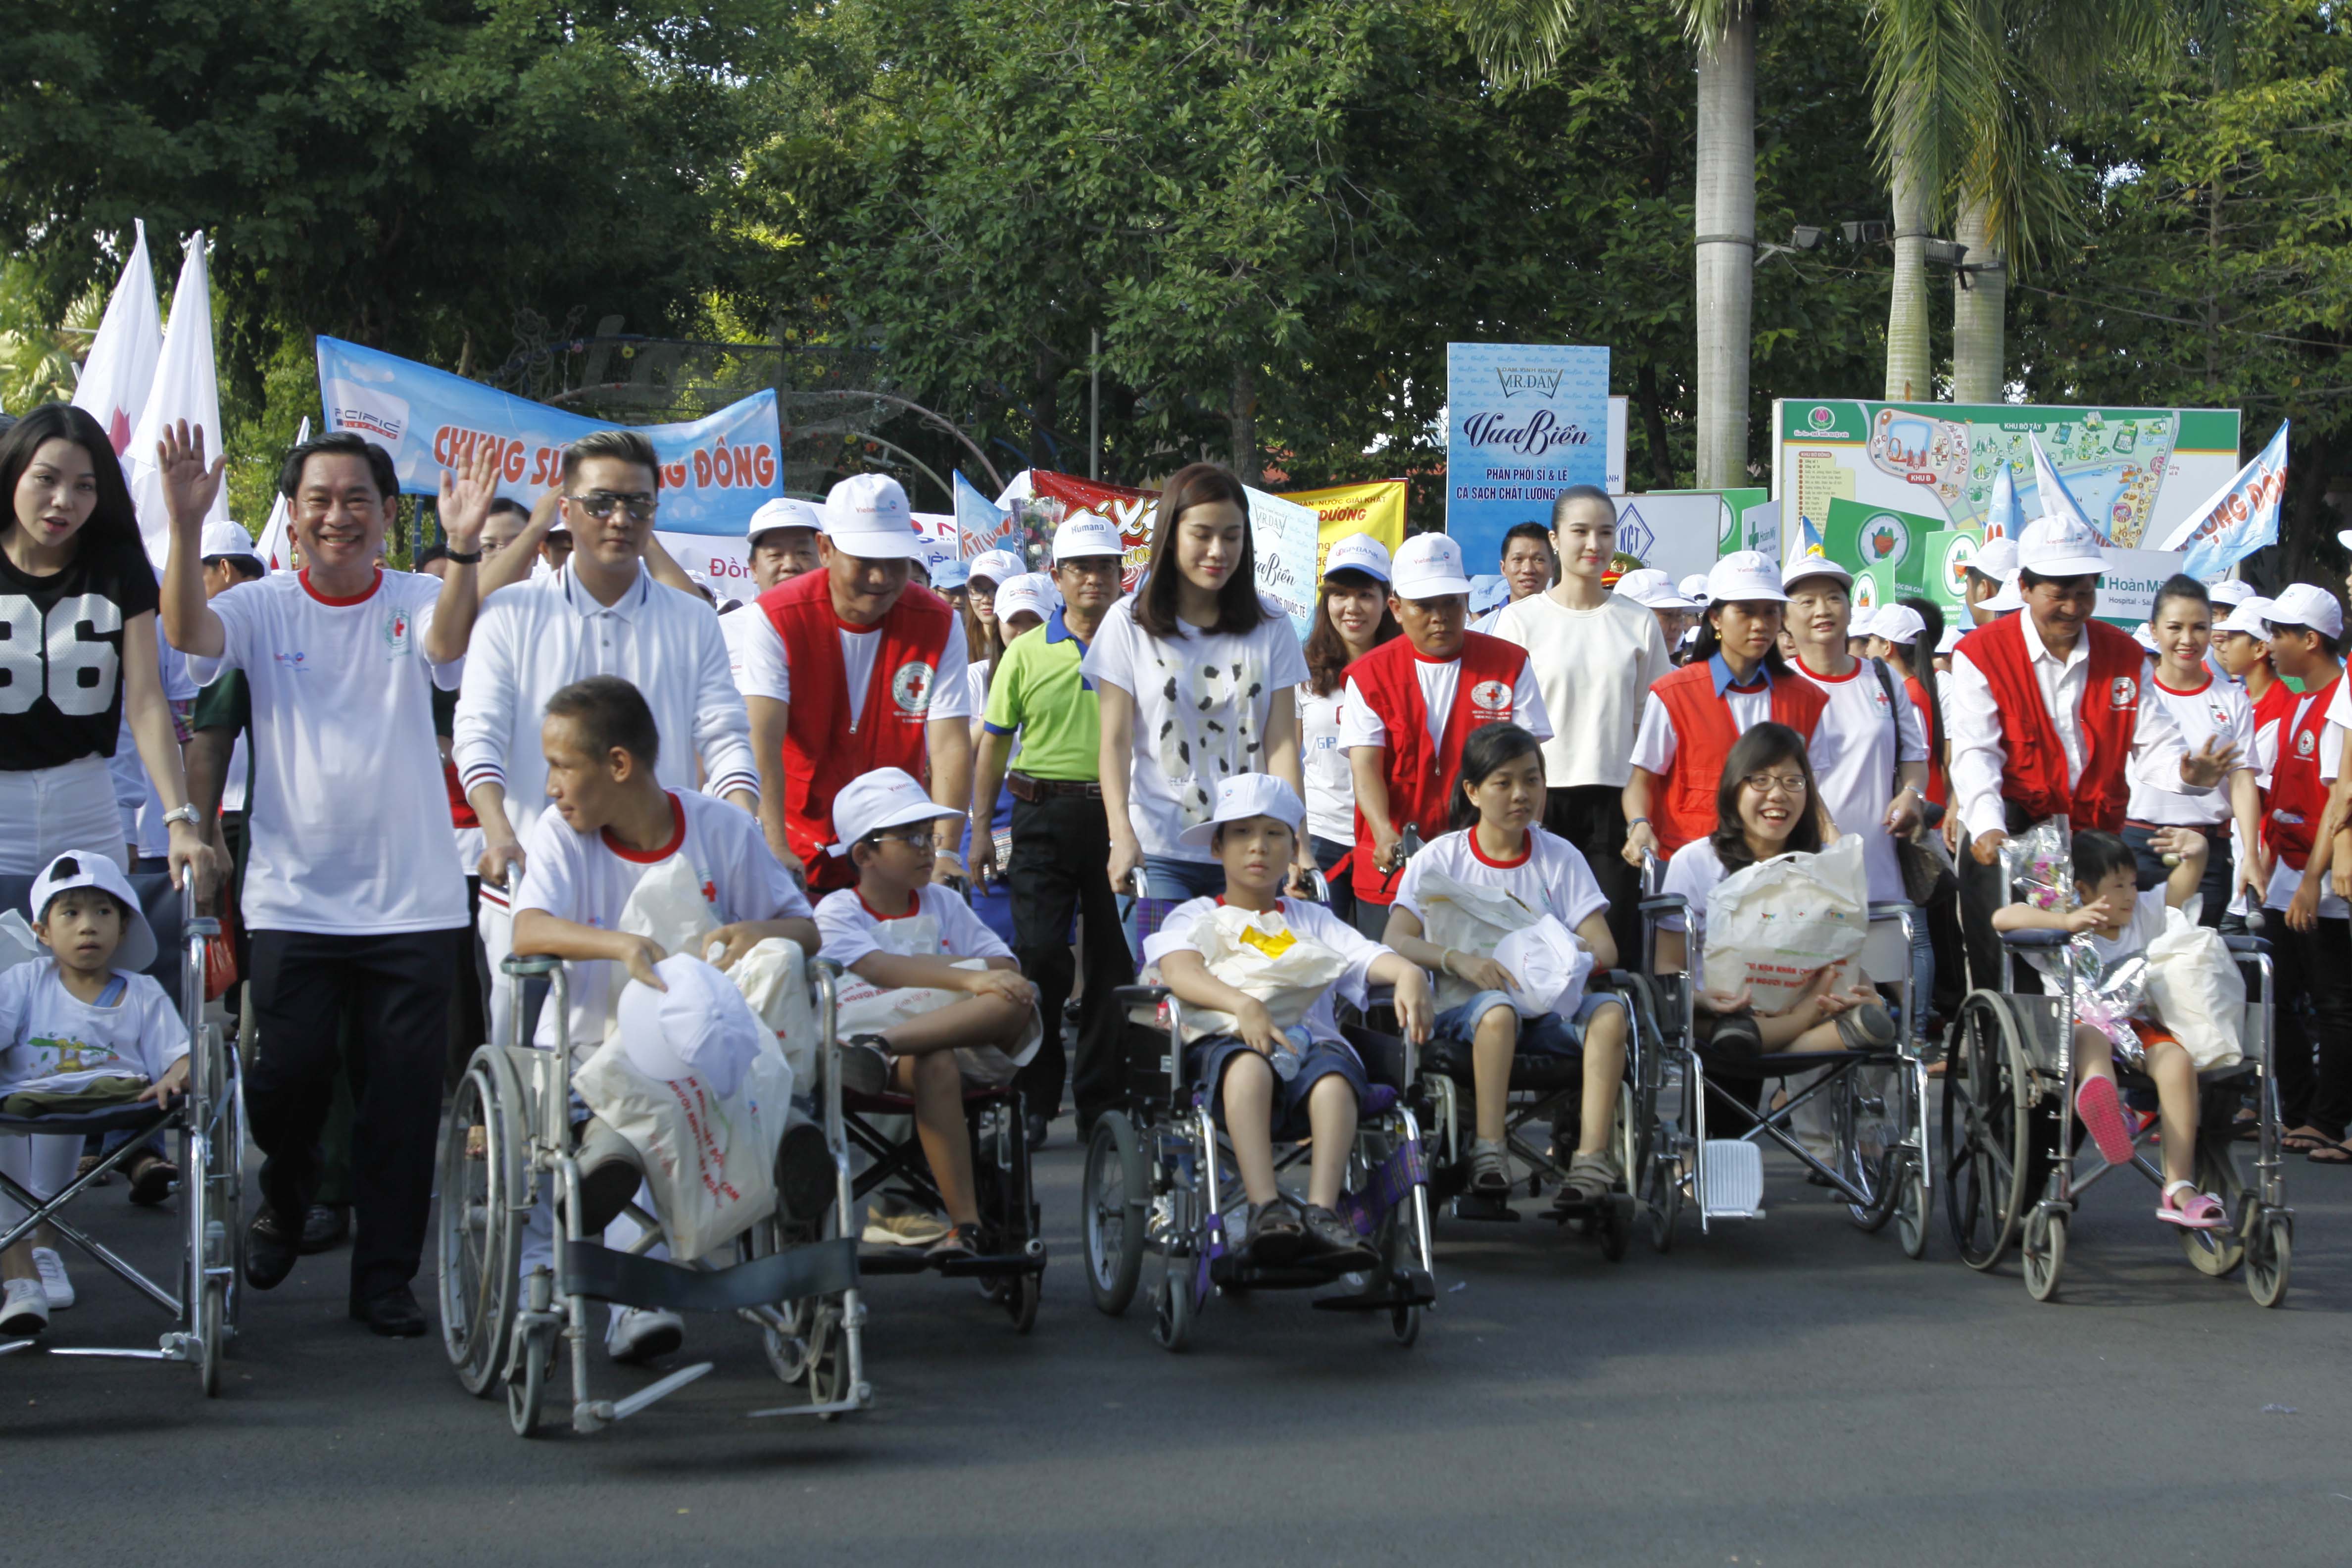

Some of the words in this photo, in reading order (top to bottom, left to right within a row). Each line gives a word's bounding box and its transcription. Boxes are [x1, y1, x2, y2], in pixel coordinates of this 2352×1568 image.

[335, 408, 400, 433] PCIFIC
[1486, 467, 1510, 481] PHÂN
[1513, 465, 1534, 481] PHỐI
[1549, 470, 1555, 481] &
[1456, 484, 1469, 499] CÁ
[1471, 487, 1496, 503] SẠCH
[1499, 483, 1522, 500] CHẤT
[1525, 486, 1556, 503] LƯỢNG
[1319, 506, 1367, 521] DƯƠNG
[1071, 523, 1105, 535] Humana
[1620, 524, 1640, 555] KCT
[2108, 577, 2144, 592] Hoàn
[2108, 596, 2136, 606] Hospital
